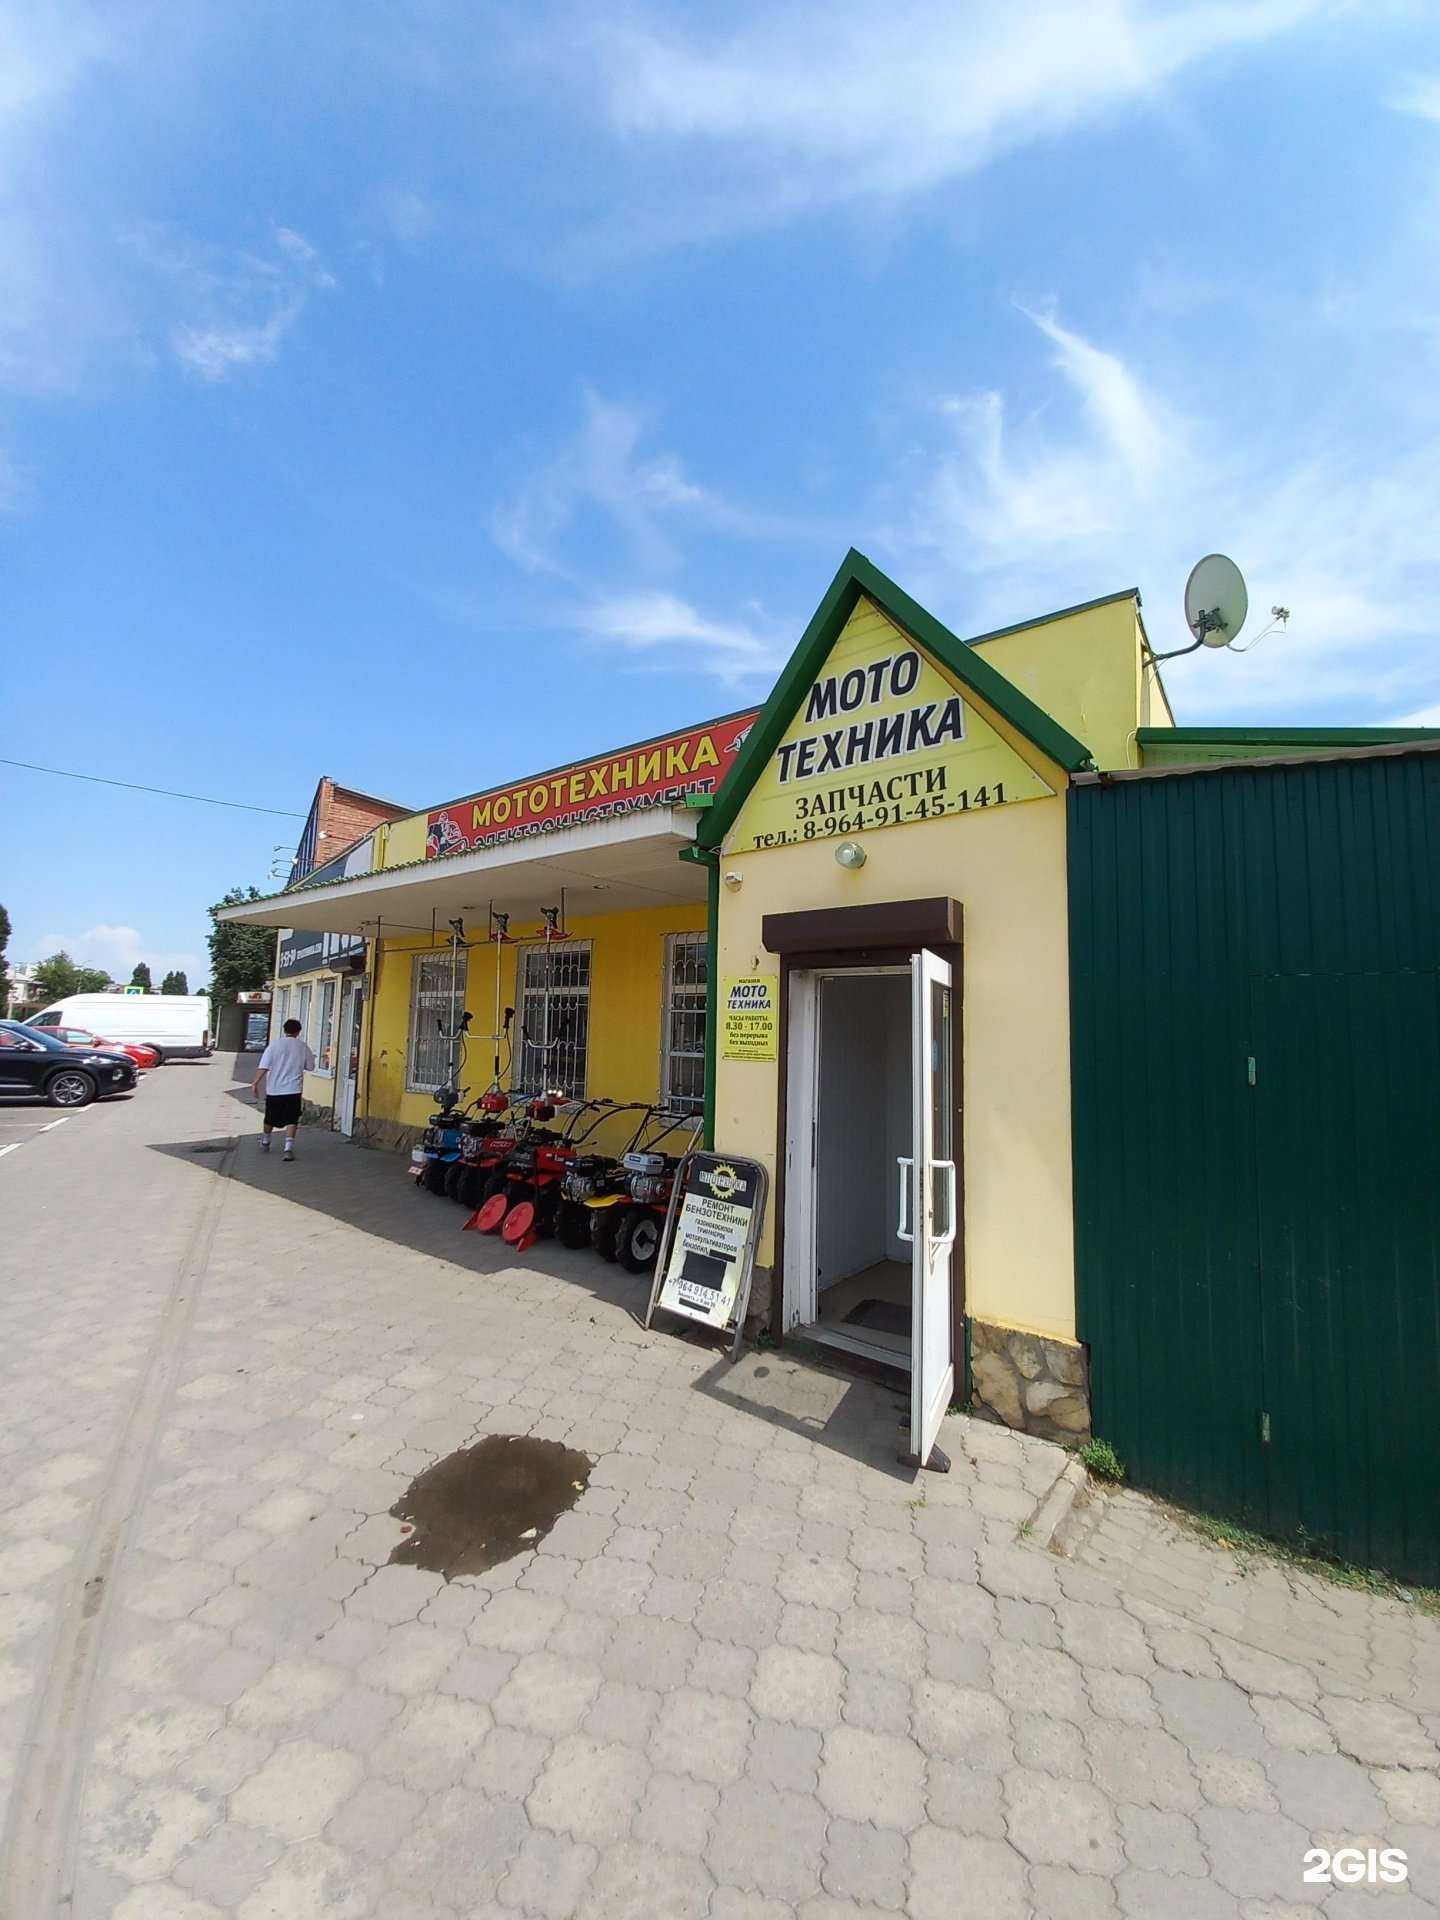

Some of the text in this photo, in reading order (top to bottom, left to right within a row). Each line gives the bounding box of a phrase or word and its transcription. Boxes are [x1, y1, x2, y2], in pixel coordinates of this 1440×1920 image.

[804, 650, 921, 725] МОТО
[776, 697, 965, 784] ТЕХНИКА
[471, 735, 721, 831] МОТОТЕХНИКА
[795, 765, 948, 820] ЗАПЧАСТИ
[753, 782, 1008, 850] тел.: 8-964-91-45-141
[727, 999, 771, 1010] ТЕХНИКА
[730, 985, 767, 998] МОТО
[725, 1022, 743, 1031] 8.30
[750, 1022, 773, 1031] 17.00
[685, 1204, 748, 1227] БЕНЗОТЕХНИКИ
[702, 1198, 735, 1213] РЕМОНТ
